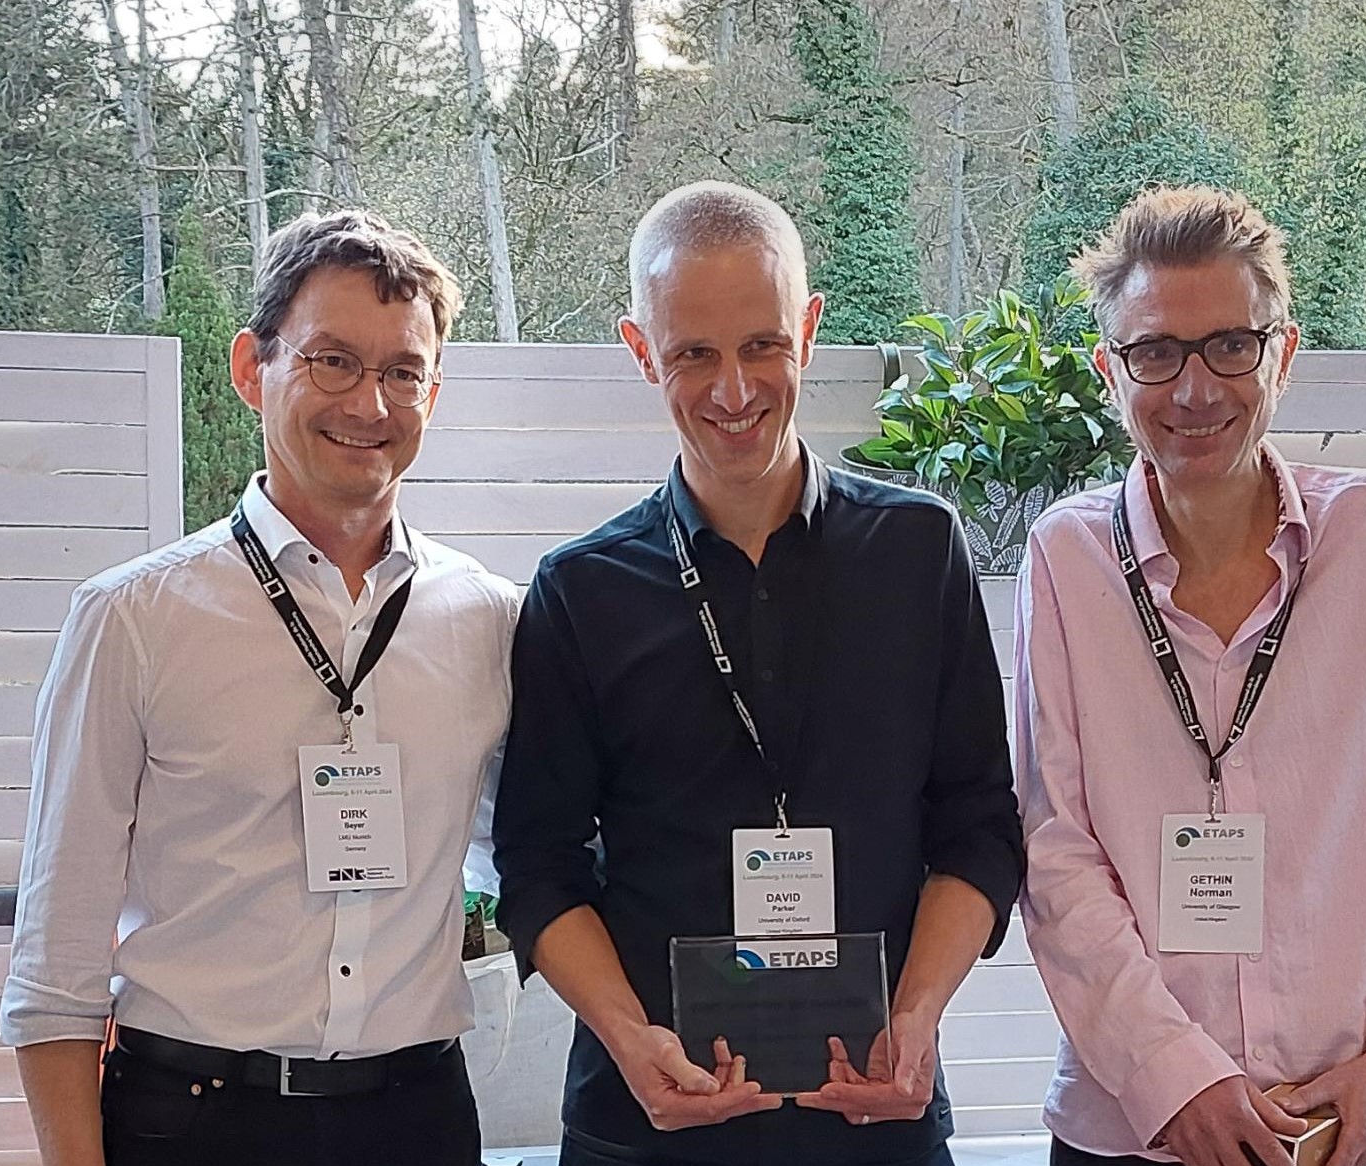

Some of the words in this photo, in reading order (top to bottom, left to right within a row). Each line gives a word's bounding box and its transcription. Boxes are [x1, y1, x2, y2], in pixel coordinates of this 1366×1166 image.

[341, 766, 381, 777] ETAPS
[340, 809, 368, 820] DIRK
[1202, 828, 1245, 838] ETAPS
[773, 851, 813, 861] ETAPS
[1190, 875, 1233, 885] GETHIN
[1189, 888, 1233, 897] Norman
[766, 893, 801, 903] DAVID
[769, 950, 837, 967] ETAPS
